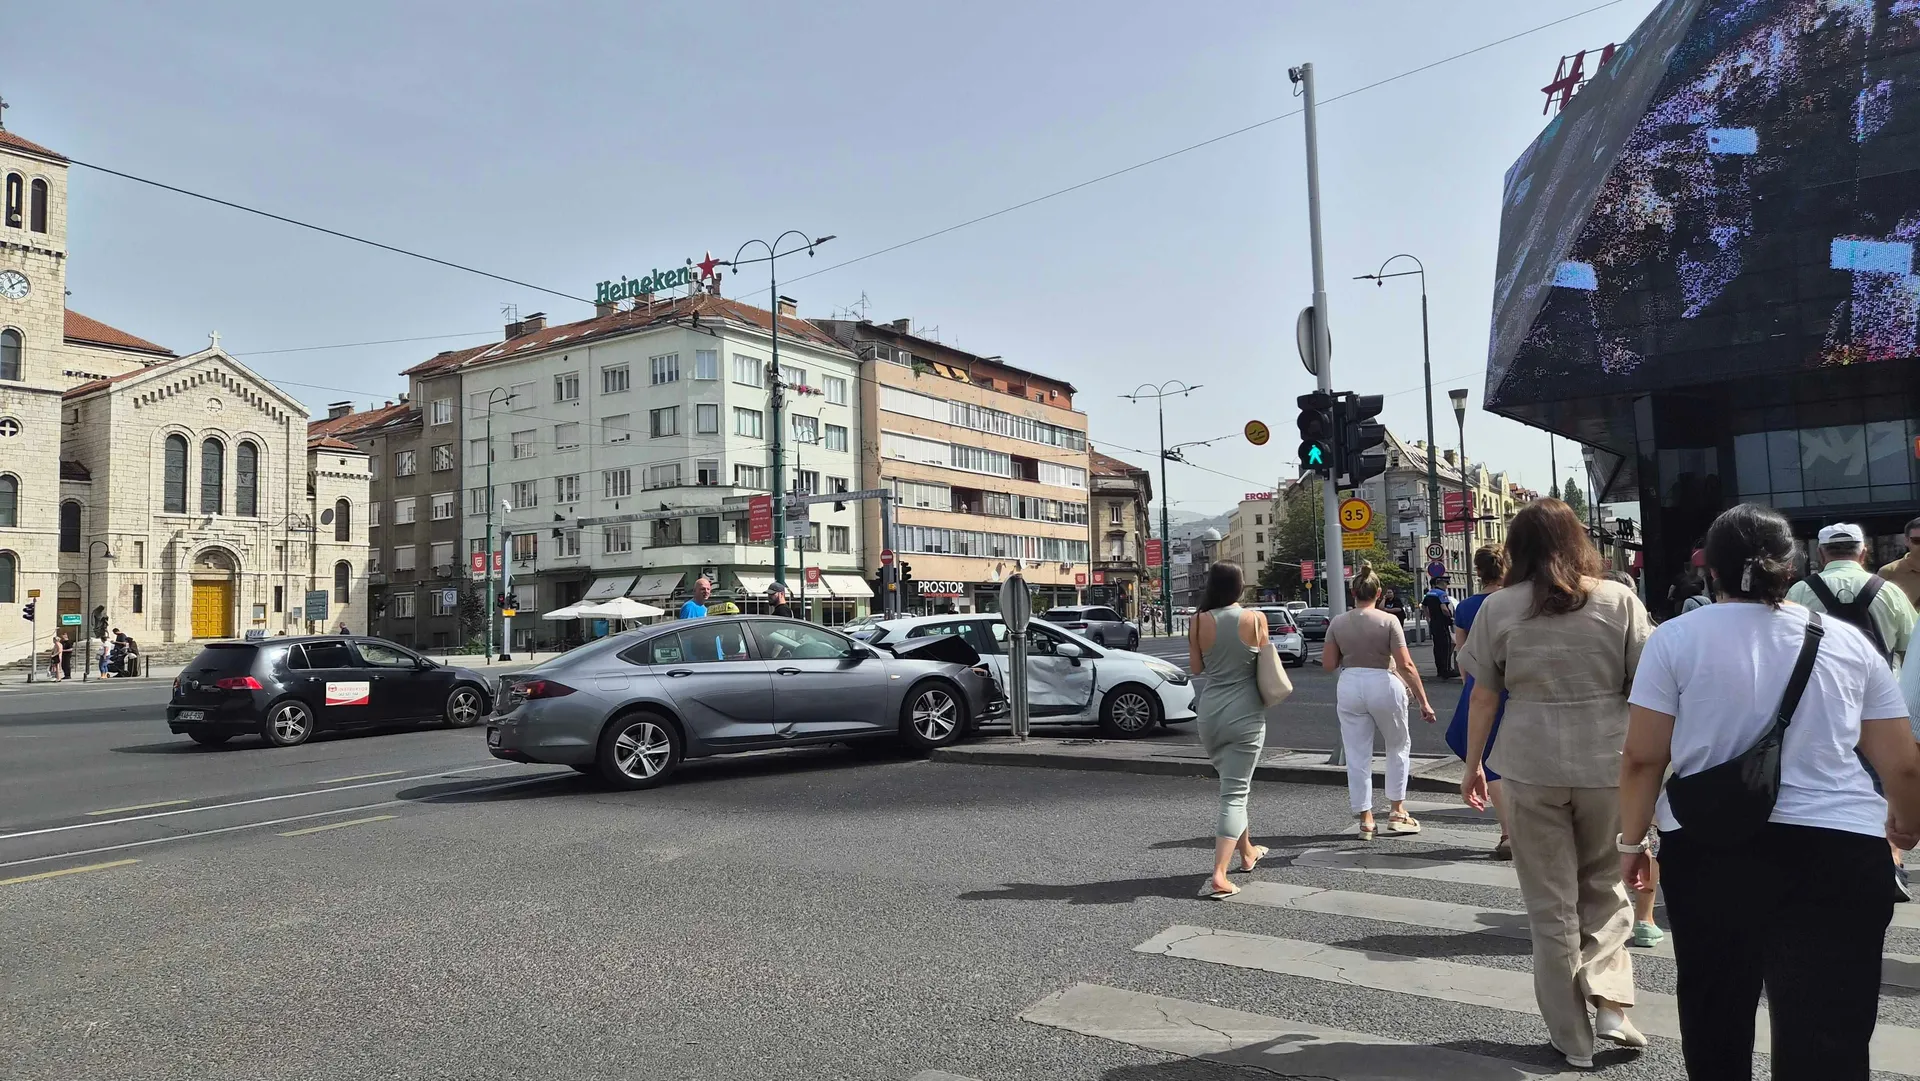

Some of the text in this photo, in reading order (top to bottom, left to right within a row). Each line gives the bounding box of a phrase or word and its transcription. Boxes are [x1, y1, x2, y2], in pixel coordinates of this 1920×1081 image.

[596, 267, 689, 304] Heineken
[1429, 547, 1441, 556] 60
[918, 581, 964, 593] PROSTOR
